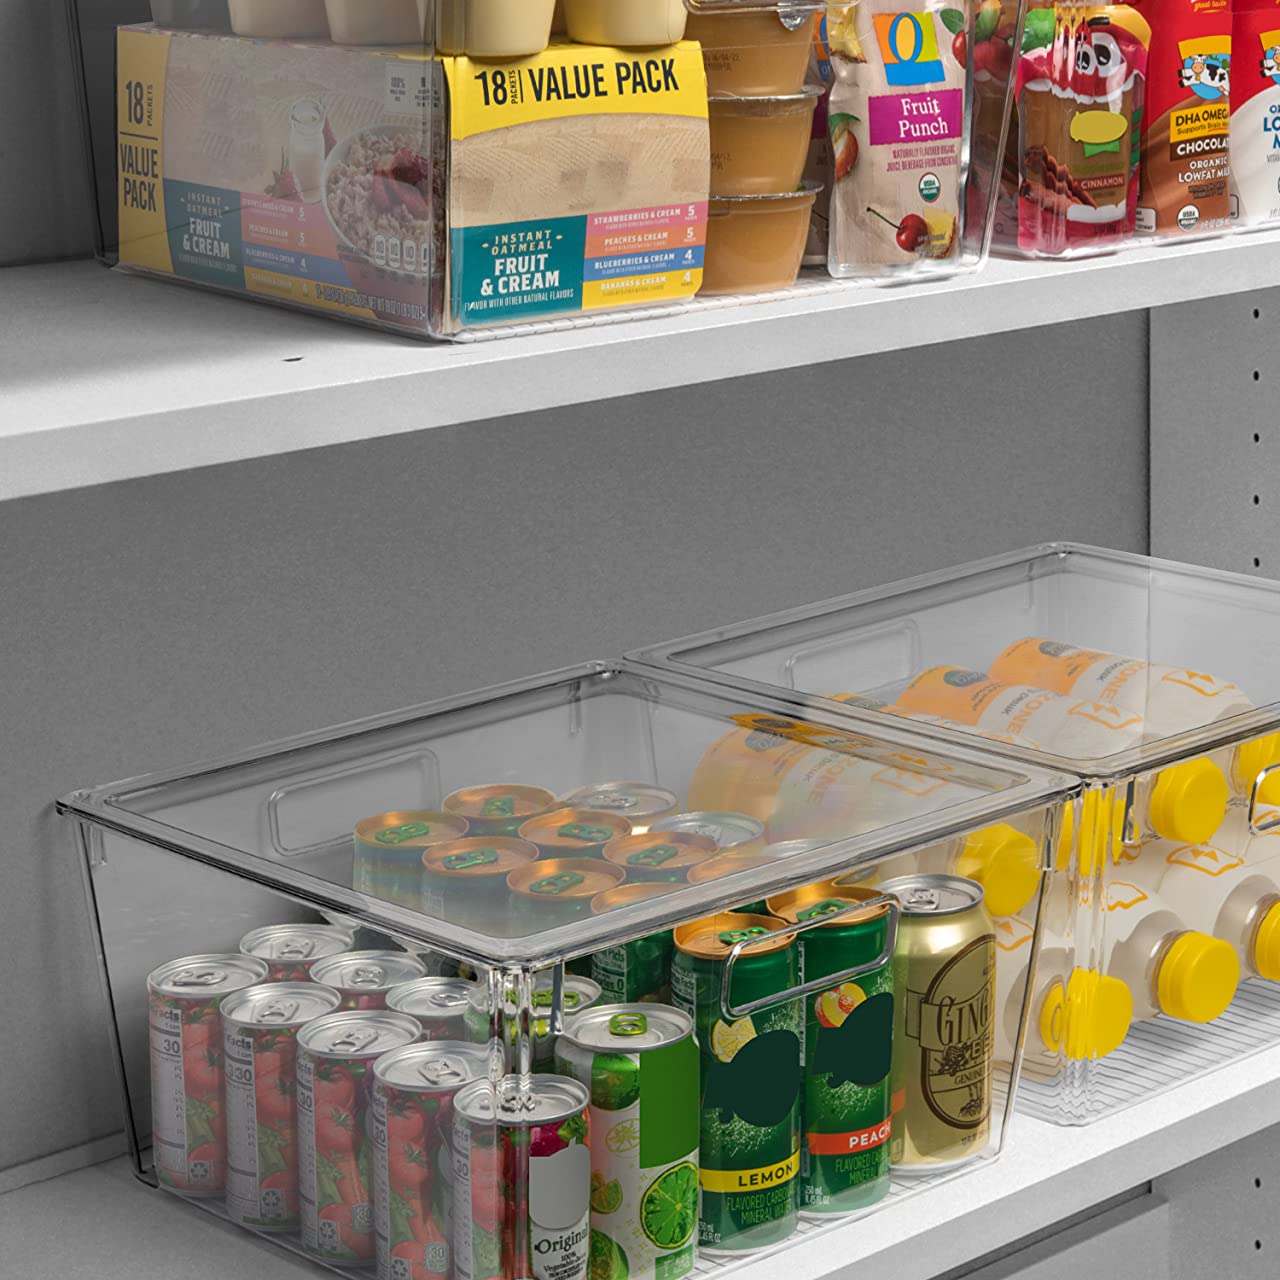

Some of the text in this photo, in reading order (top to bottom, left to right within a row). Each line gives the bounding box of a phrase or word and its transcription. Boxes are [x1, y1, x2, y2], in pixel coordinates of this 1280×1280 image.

[474, 70, 508, 106] 18
[528, 63, 608, 102] VALUE
[616, 58, 679, 95] PACK
[125, 80, 144, 125] 18
[901, 97, 941, 116] Fruit
[899, 117, 949, 138] Punch
[1175, 114, 1201, 127] DHA
[1177, 123, 1206, 135] Supports
[120, 143, 158, 179] VALUE
[1189, 156, 1228, 170] ORGANIC
[1081, 176, 1123, 189] CINNAMON
[1178, 169, 1215, 183] LOWFAT
[124, 177, 157, 213] PACK
[594, 211, 649, 225] STRAWBERRIES
[656, 208, 680, 217] CREAM
[688, 205, 695, 217] 5
[190, 217, 221, 239] FRUIT
[495, 229, 551, 245] INSTANT
[604, 235, 637, 246] PEACHES
[643, 232, 668, 241] CREAM
[687, 227, 694, 238] 5
[183, 234, 230, 259] & CREAM
[491, 240, 552, 256] OATMEAL
[495, 253, 549, 276] FRUIT
[595, 256, 643, 269] BLUEBERRIES
[650, 253, 675, 263] CREAM
[685, 249, 693, 260] 4
[481, 270, 560, 296] & CREAM
[601, 278, 634, 290] BANANAS
[642, 276, 666, 285] CREAM
[683, 272, 691, 282] 4
[488, 298, 504, 308] WITH
[505, 296, 522, 306] OTHER
[524, 293, 548, 304] NATURAL
[549, 289, 574, 300] FLAVORS
[616, 978, 624, 991] 0
[164, 1038, 180, 1054] 30
[849, 1121, 891, 1148] PEACH
[835, 1152, 870, 1173] FLAVORED
[738, 1162, 793, 1187] LEMON
[727, 1194, 764, 1211] FLAVORED
[741, 1210, 772, 1224] MINERAL
[535, 1221, 588, 1254] Original
